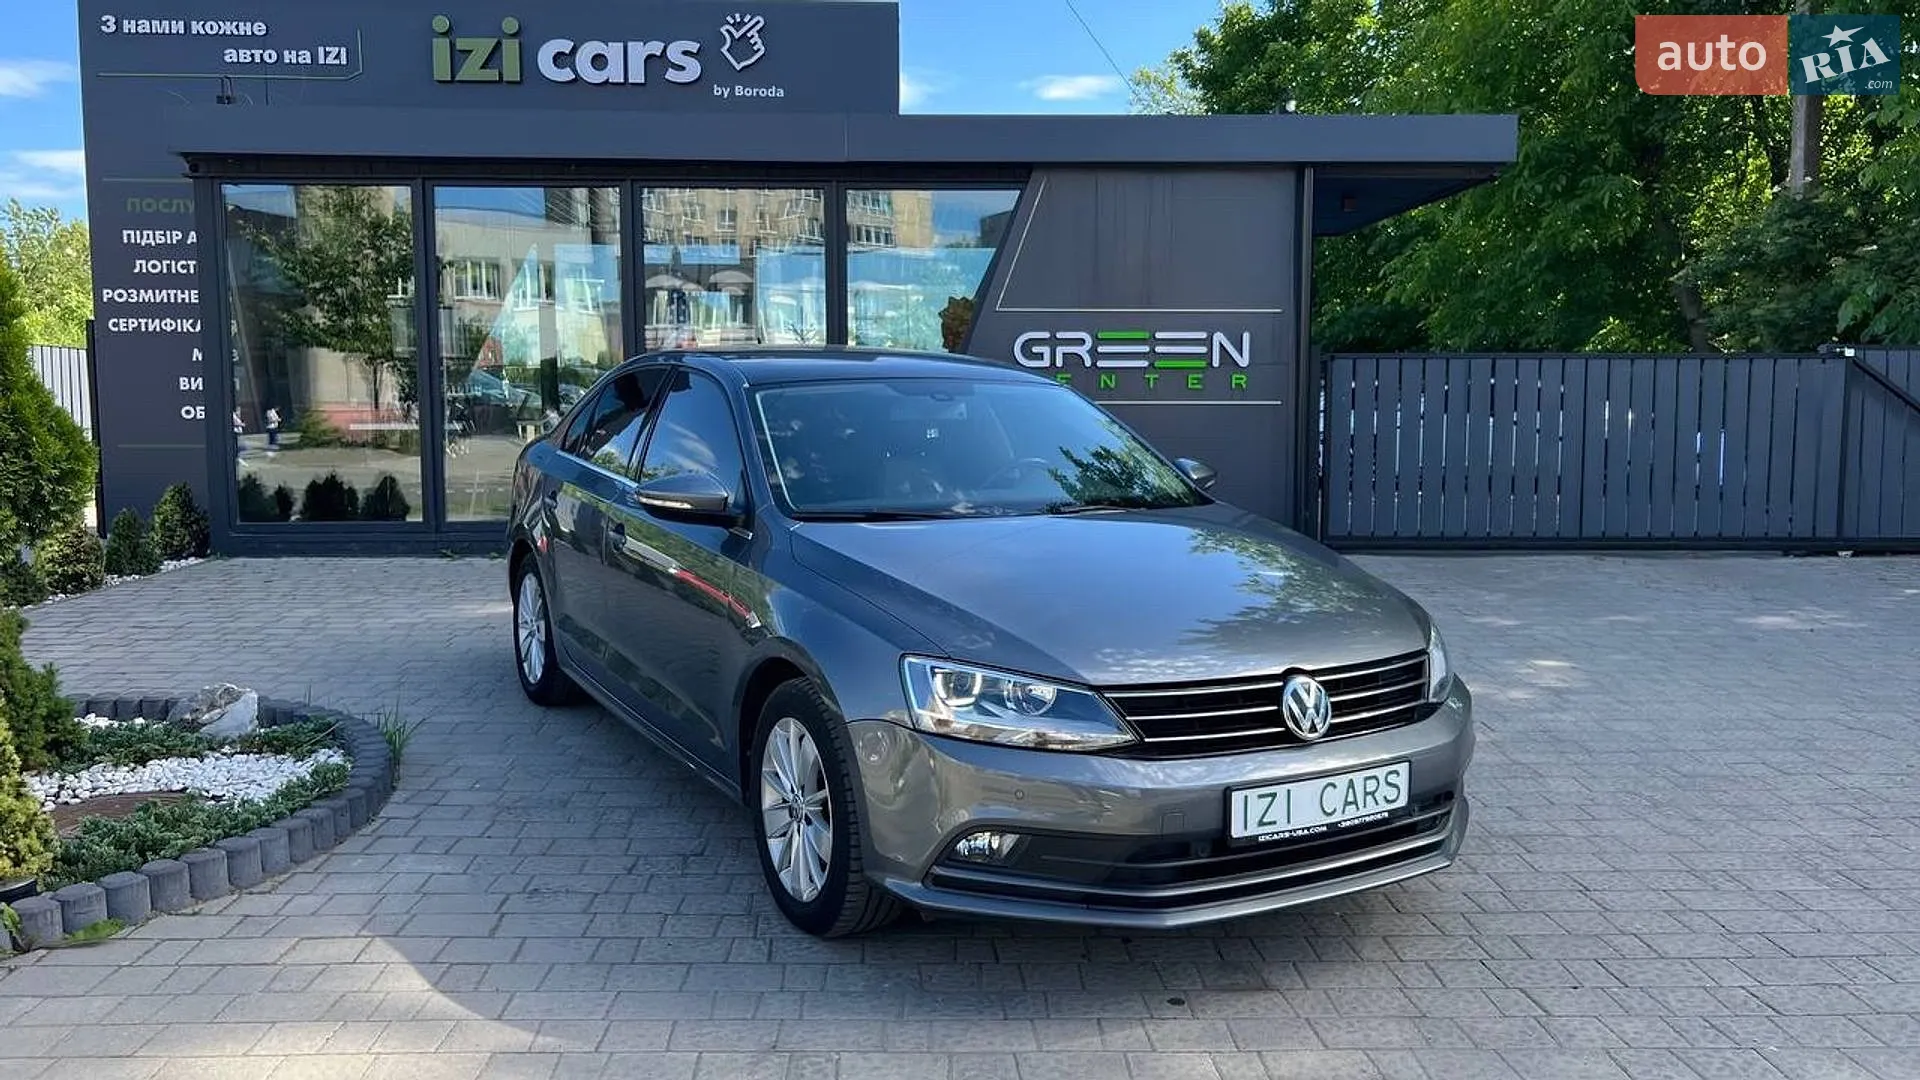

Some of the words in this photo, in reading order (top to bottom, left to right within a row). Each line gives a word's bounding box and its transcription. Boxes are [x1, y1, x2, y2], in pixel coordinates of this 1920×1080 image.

[101, 15, 117, 34] З
[123, 19, 185, 35] нами
[191, 20, 268, 36] кожне
[224, 48, 278, 65] авто
[284, 50, 312, 65] на
[318, 46, 348, 66] IZI
[431, 14, 522, 83] izi
[537, 38, 702, 84] cars
[713, 84, 731, 99] by
[735, 85, 786, 98] Boroda
[122, 230, 183, 246] ПІДБІР
[102, 289, 199, 304] РОЗМИТНЕ
[1013, 331, 1250, 368] GREEN
[1243, 788, 1292, 831] IZI
[1320, 769, 1401, 818] CARS
